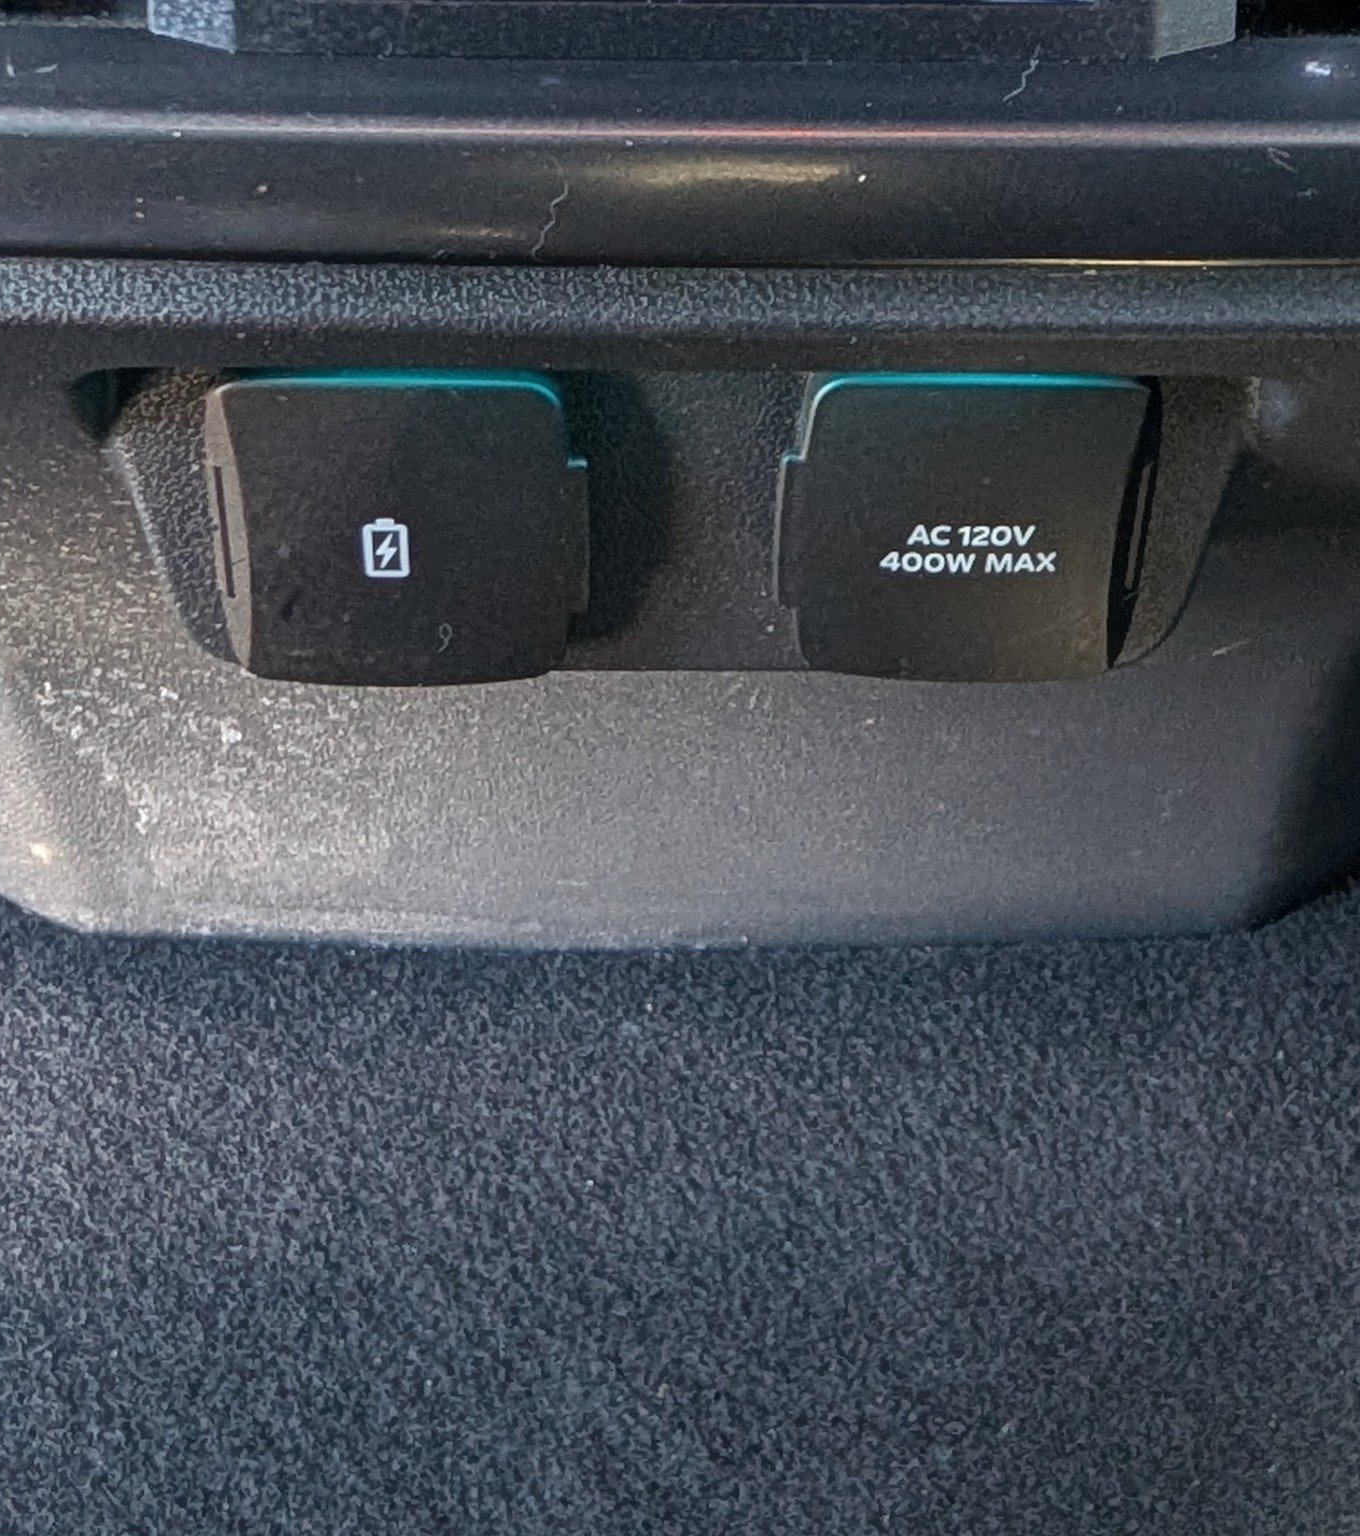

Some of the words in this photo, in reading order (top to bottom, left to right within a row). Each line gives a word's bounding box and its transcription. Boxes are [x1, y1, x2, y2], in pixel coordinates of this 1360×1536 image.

[906, 524, 952, 546] AC
[957, 525, 1036, 547] 120V
[879, 551, 976, 573] 400W
[984, 551, 1057, 573] MAX
